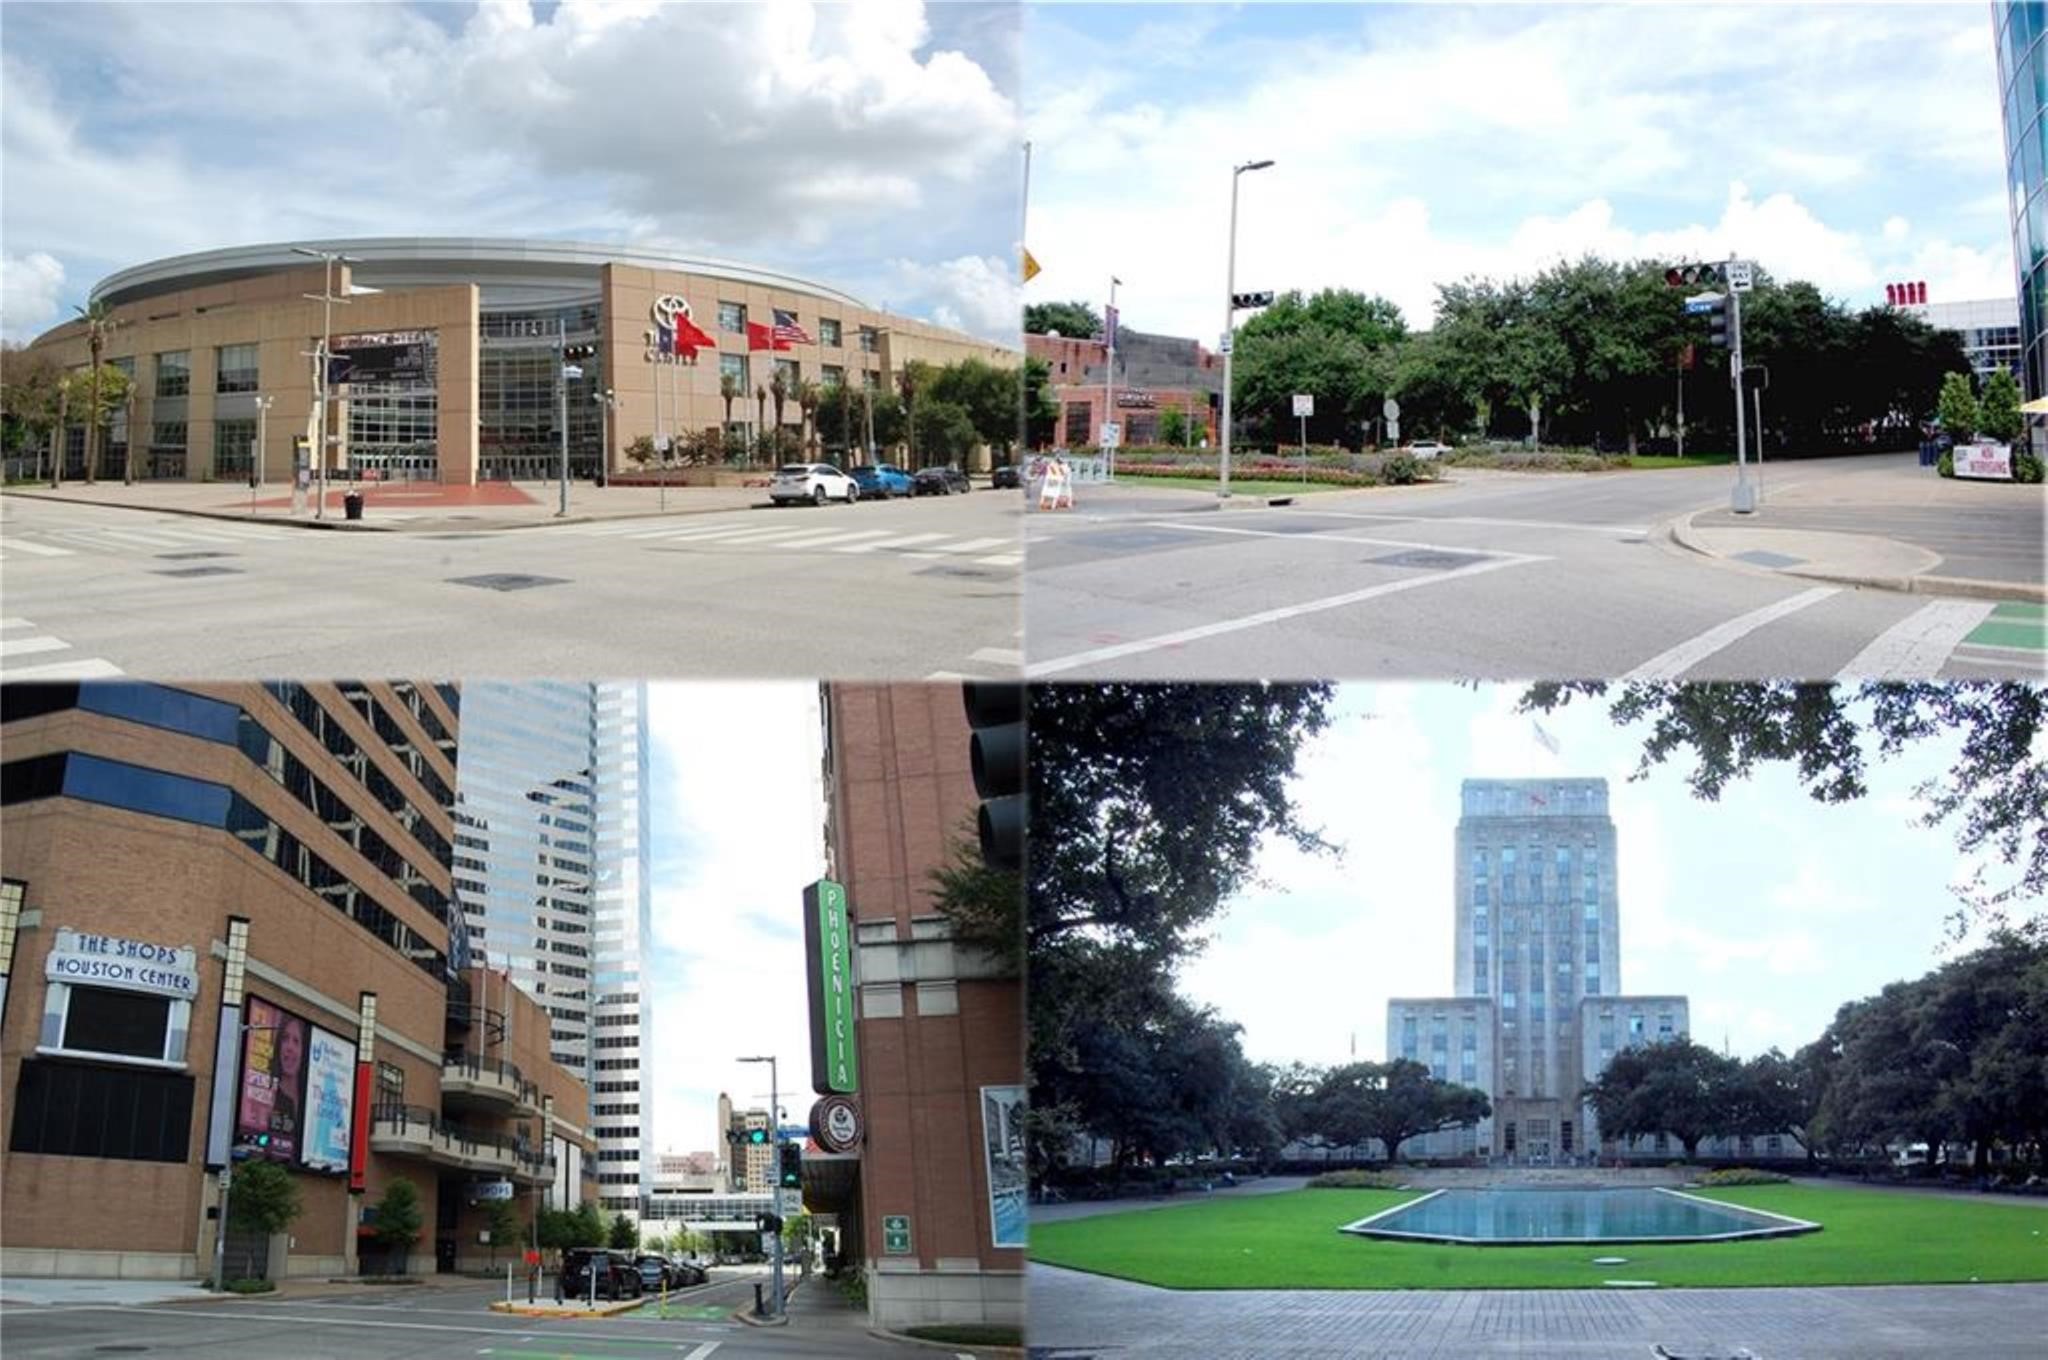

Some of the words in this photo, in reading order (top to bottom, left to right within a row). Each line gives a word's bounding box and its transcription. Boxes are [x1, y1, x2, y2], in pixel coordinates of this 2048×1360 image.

[79, 934, 109, 954] THE
[116, 939, 177, 965] SHOPS
[56, 957, 133, 980] HOUSTON
[138, 967, 191, 991] CENTER
[827, 889, 848, 1085] PHOENICIA
